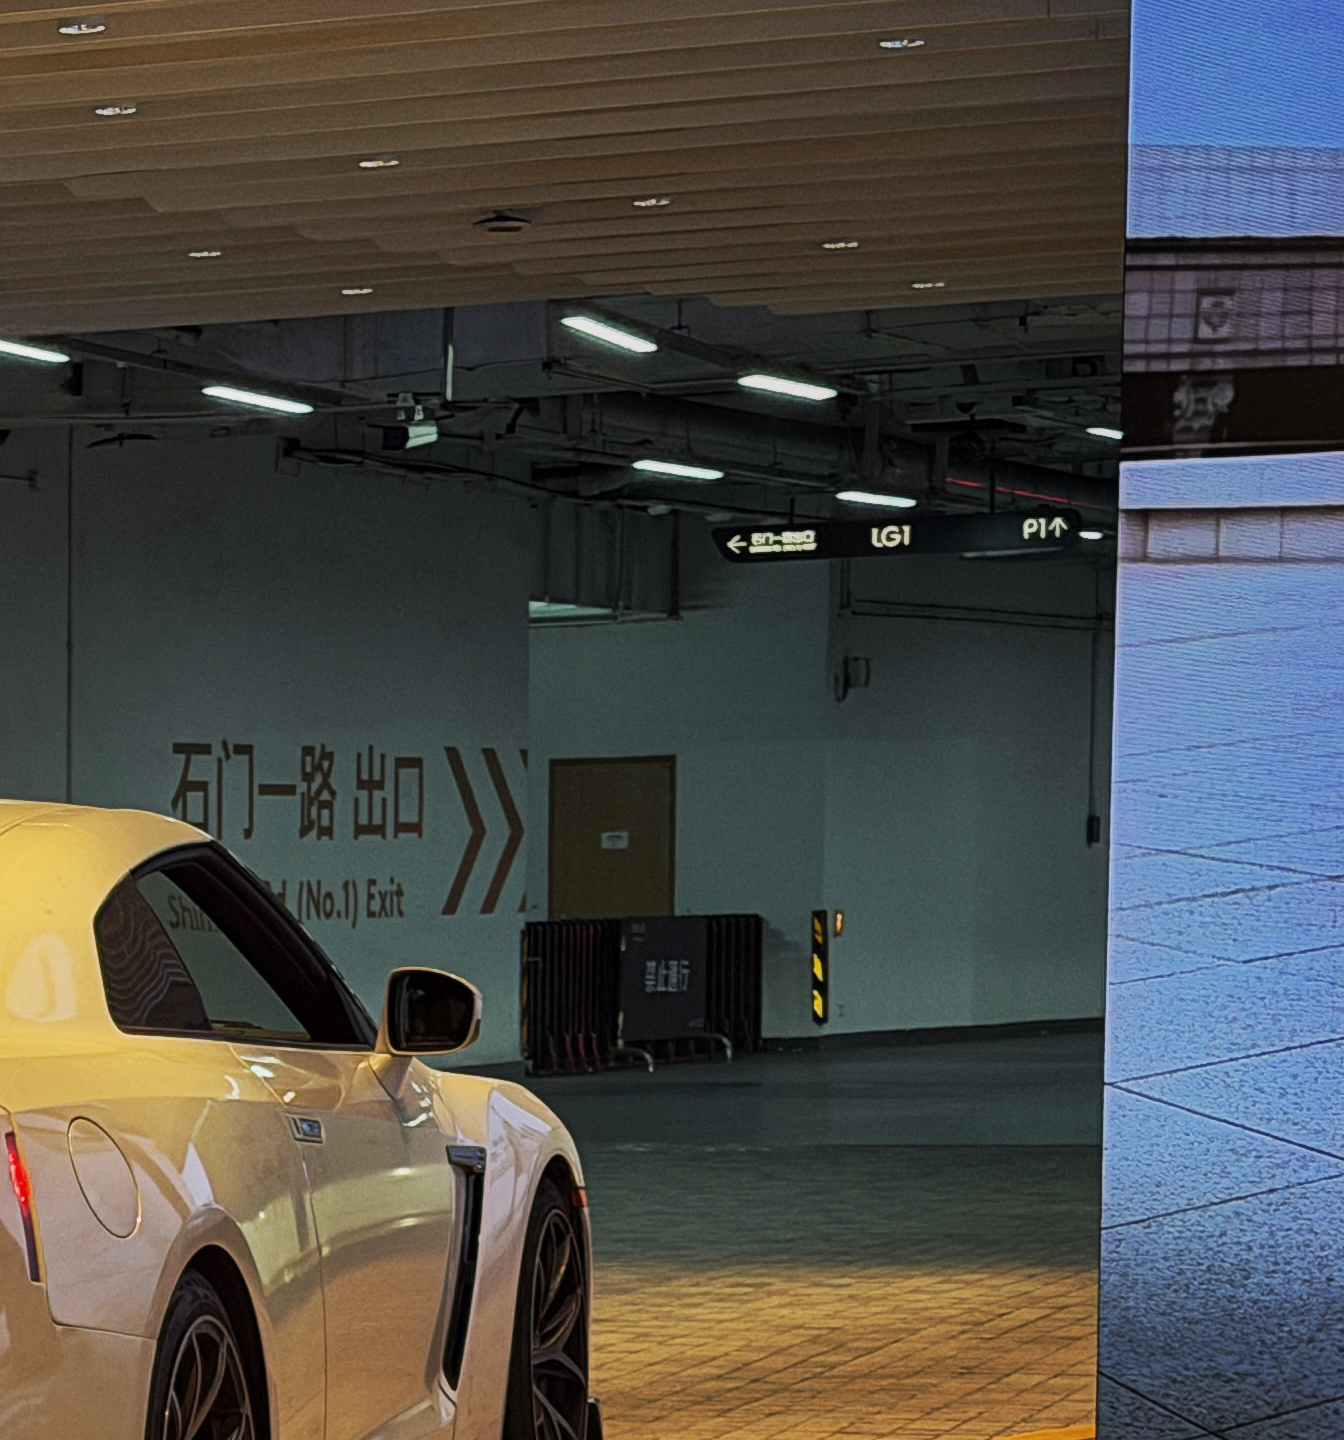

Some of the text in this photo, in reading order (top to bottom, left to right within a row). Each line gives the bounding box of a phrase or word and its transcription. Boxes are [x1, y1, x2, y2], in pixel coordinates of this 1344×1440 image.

[871, 525, 911, 548] LG1
[1023, 518, 1046, 540] P1
[171, 739, 424, 841] 石门一路 出口
[298, 879, 358, 930] (No.1)
[367, 876, 405, 919] Exit
